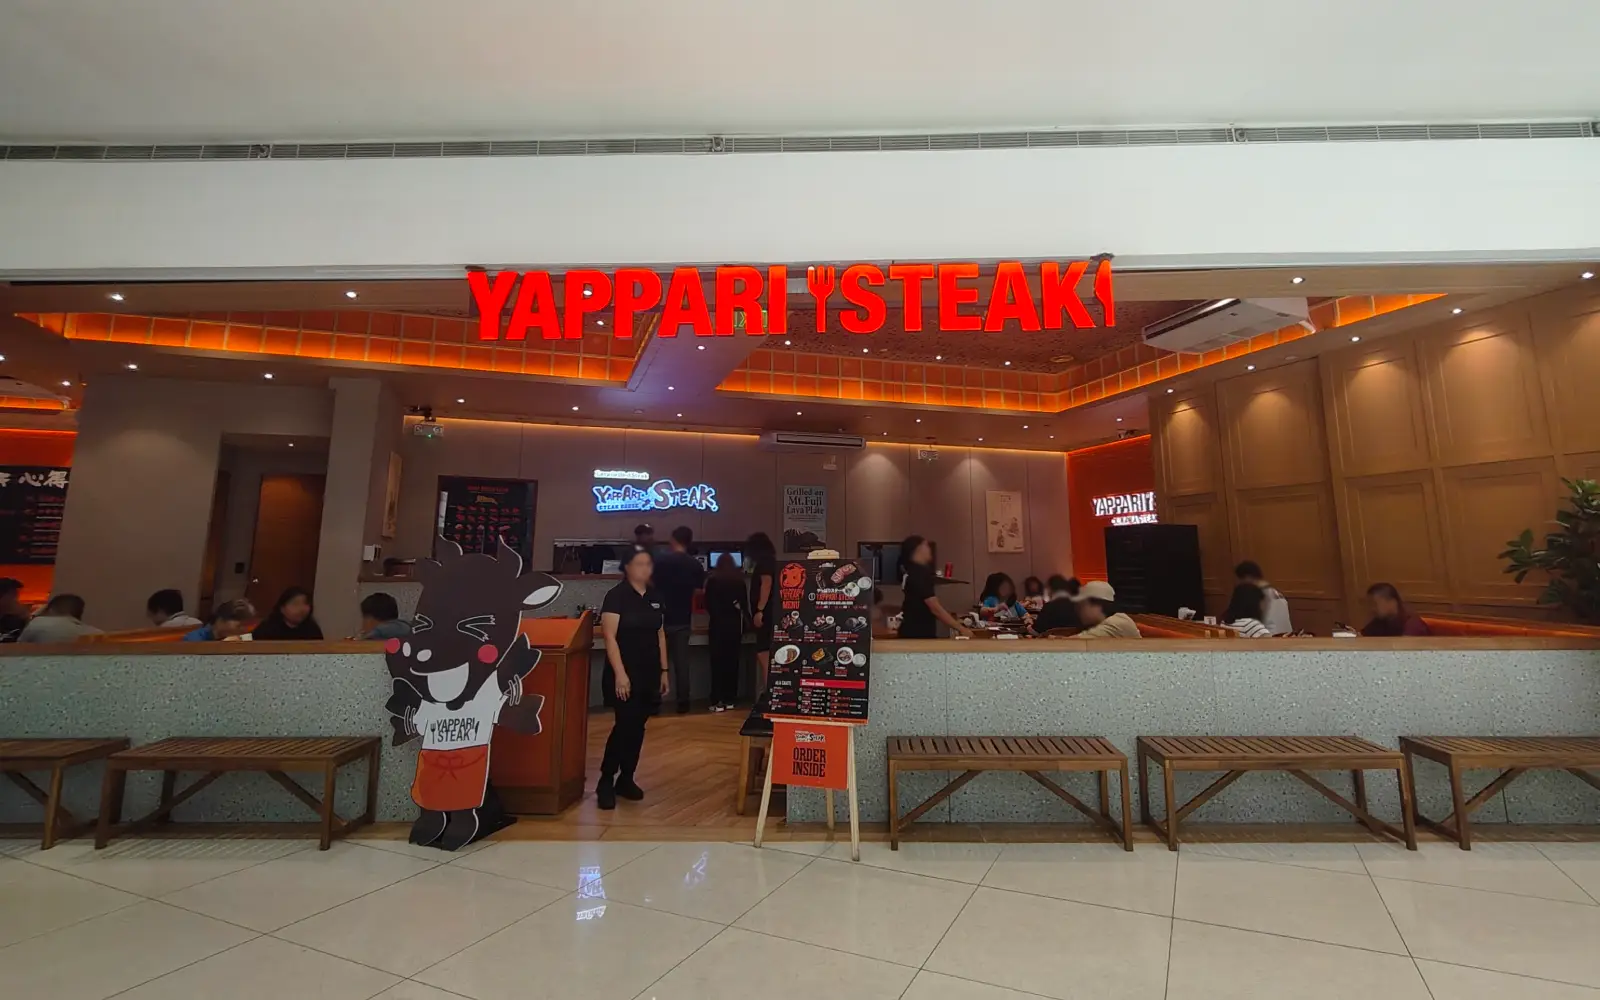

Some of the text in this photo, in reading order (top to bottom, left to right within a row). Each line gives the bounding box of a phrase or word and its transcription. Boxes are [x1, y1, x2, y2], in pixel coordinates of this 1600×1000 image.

[466, 260, 1096, 340] YAPPARI STEAK
[653, 480, 718, 511] STEAK
[786, 487, 812, 496] Grilled
[786, 506, 824, 514] Lava Plate
[1092, 493, 1146, 516] YAPPARI
[783, 600, 799, 609] MENU
[437, 717, 475, 732] YAPPARI
[438, 730, 470, 742] STEAK
[793, 746, 826, 763] ORDER
[793, 761, 825, 777] INSIDE
